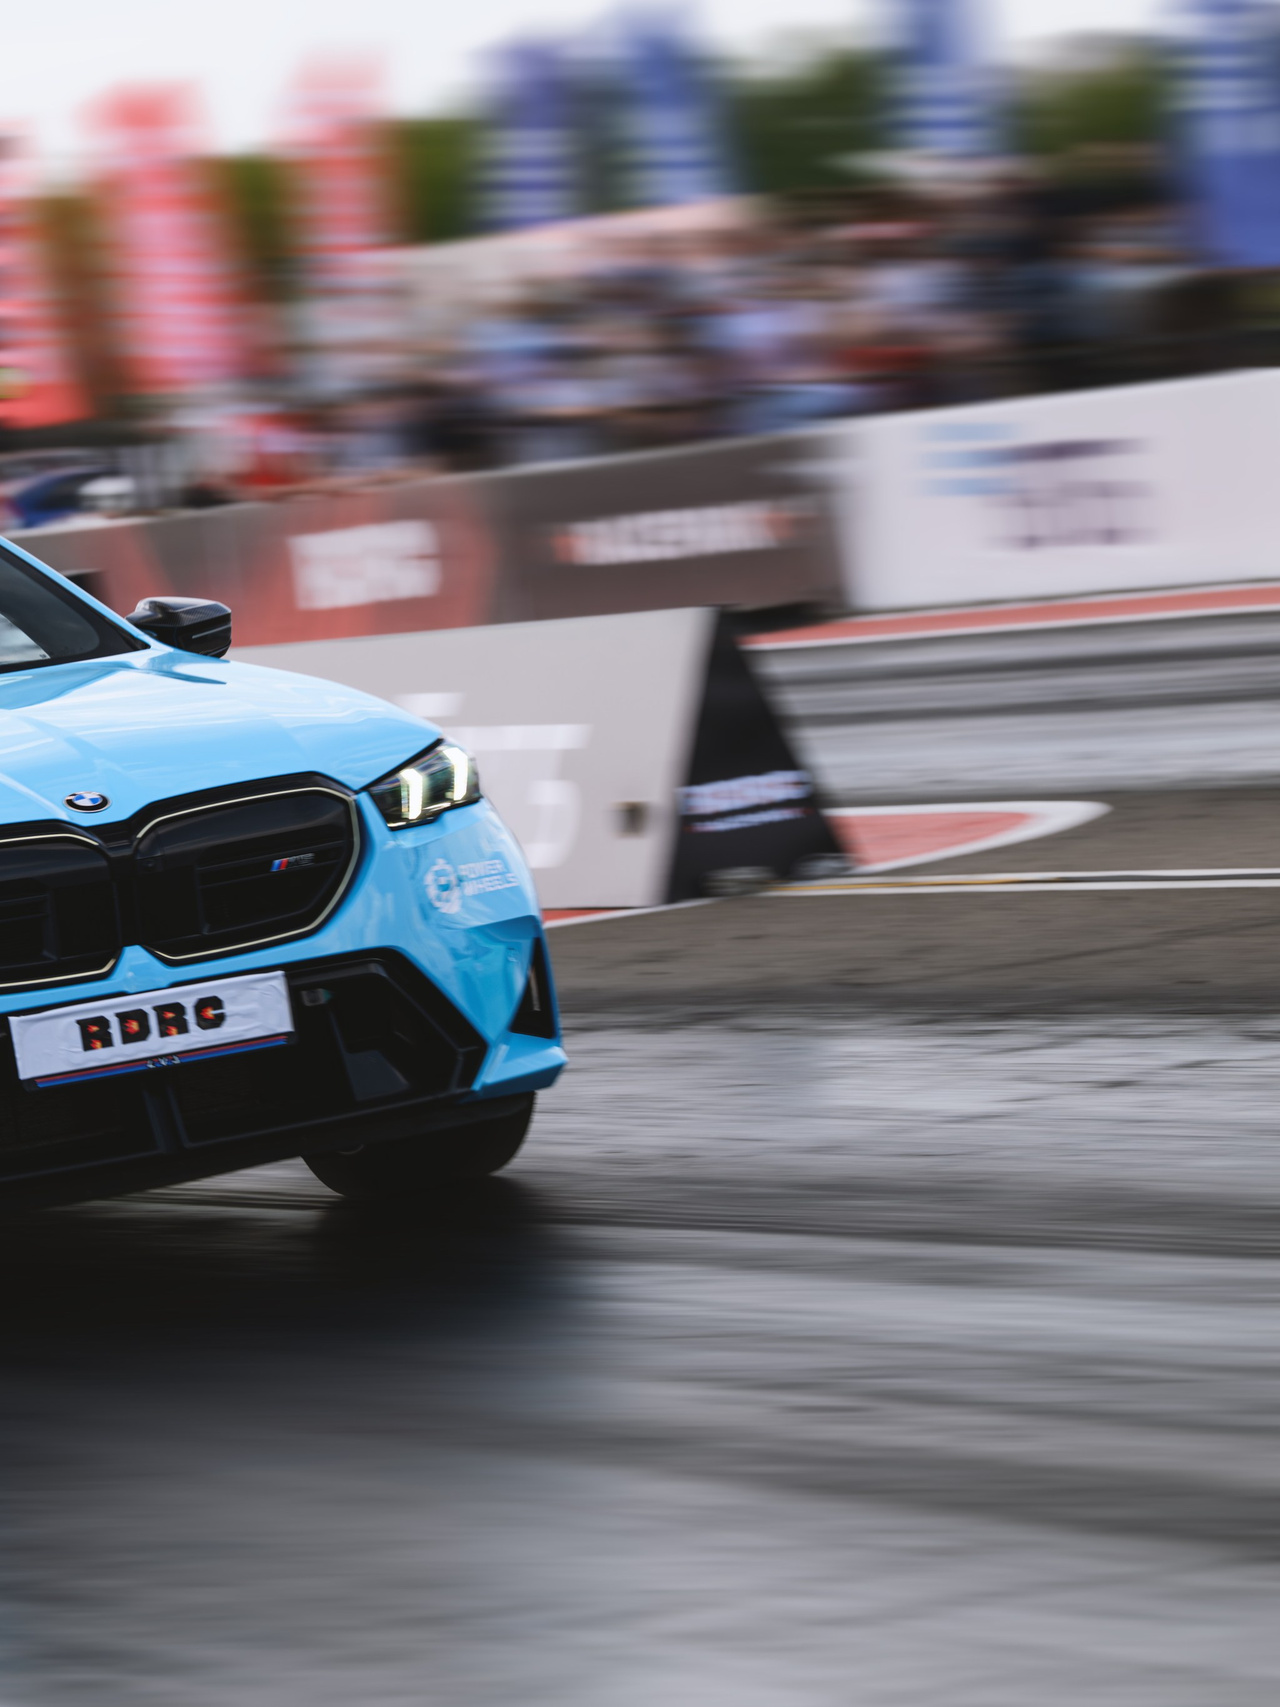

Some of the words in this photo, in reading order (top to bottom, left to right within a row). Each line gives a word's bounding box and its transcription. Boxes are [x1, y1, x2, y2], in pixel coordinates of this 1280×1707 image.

[458, 859, 504, 878] POWER
[463, 873, 519, 896] WHEELS
[76, 995, 227, 1051] RDRC
